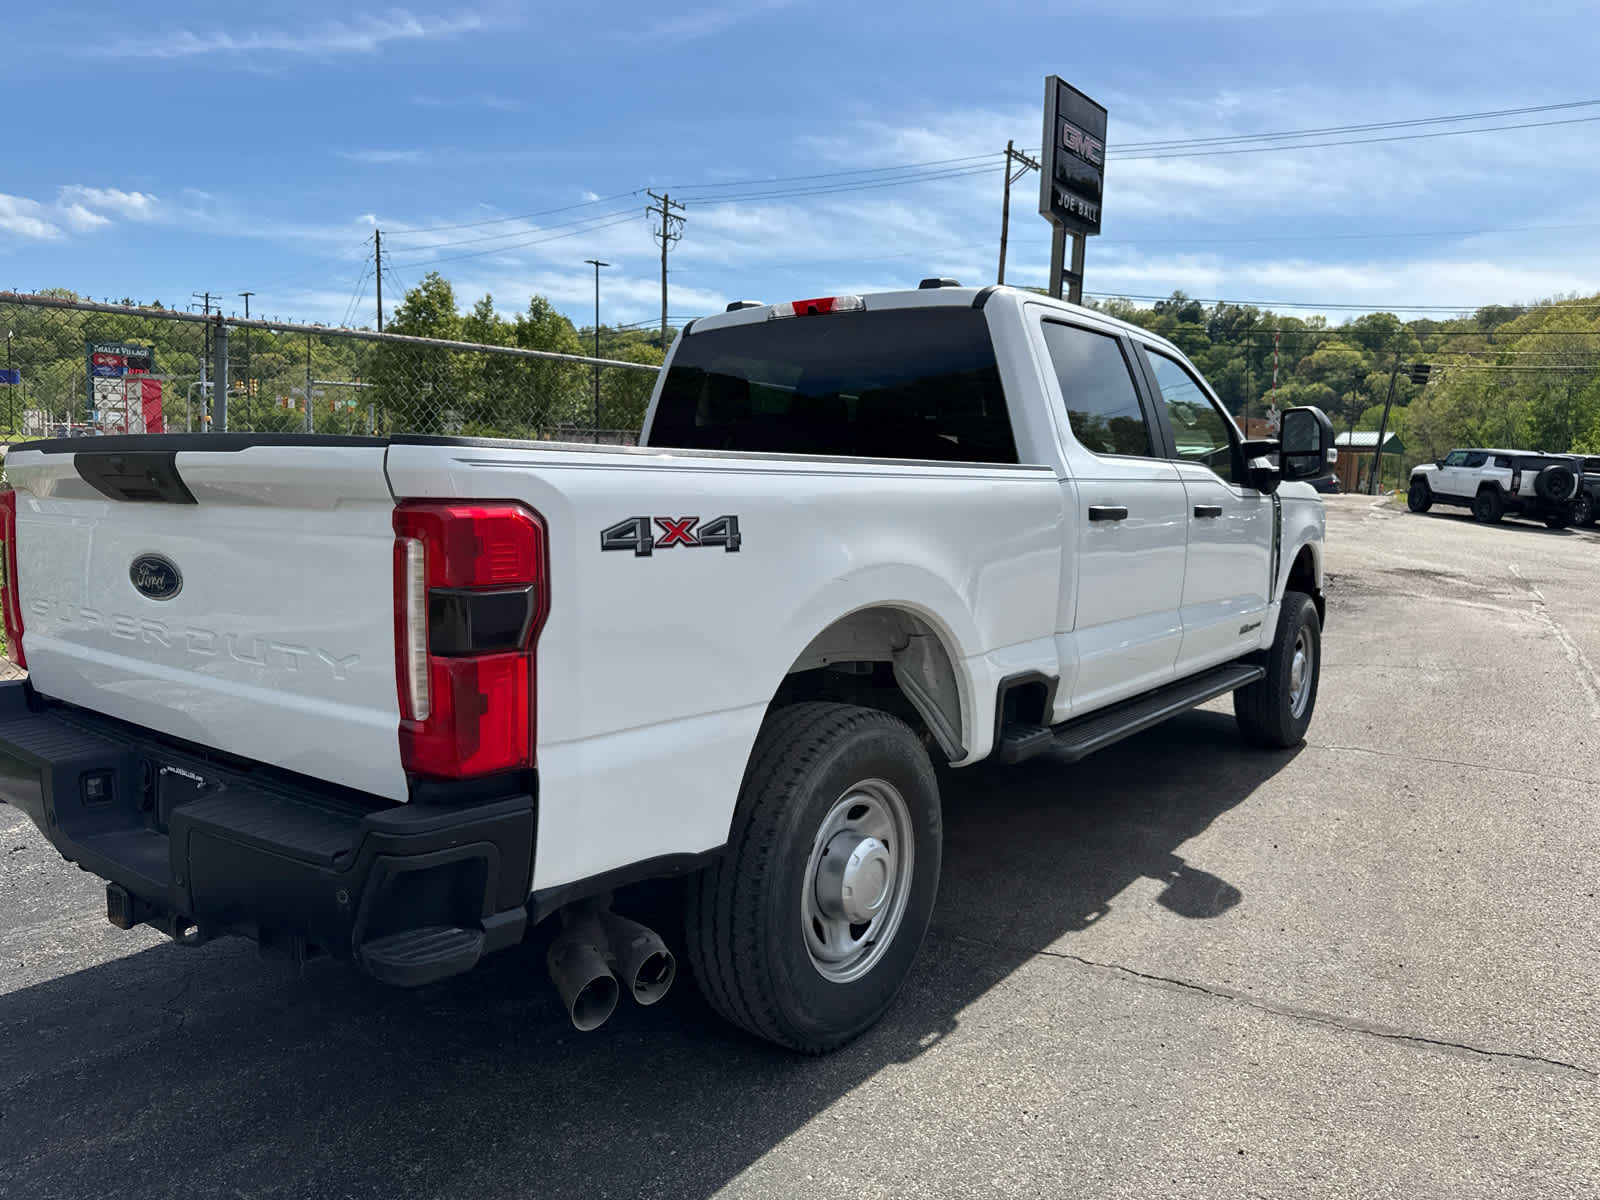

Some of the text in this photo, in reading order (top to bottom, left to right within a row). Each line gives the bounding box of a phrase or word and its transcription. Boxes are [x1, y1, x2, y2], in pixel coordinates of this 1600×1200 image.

[1063, 123, 1102, 165] GMC
[1058, 191, 1098, 223] JOE BALL
[136, 562, 167, 590] Ford
[185, 624, 361, 681] DUTY
